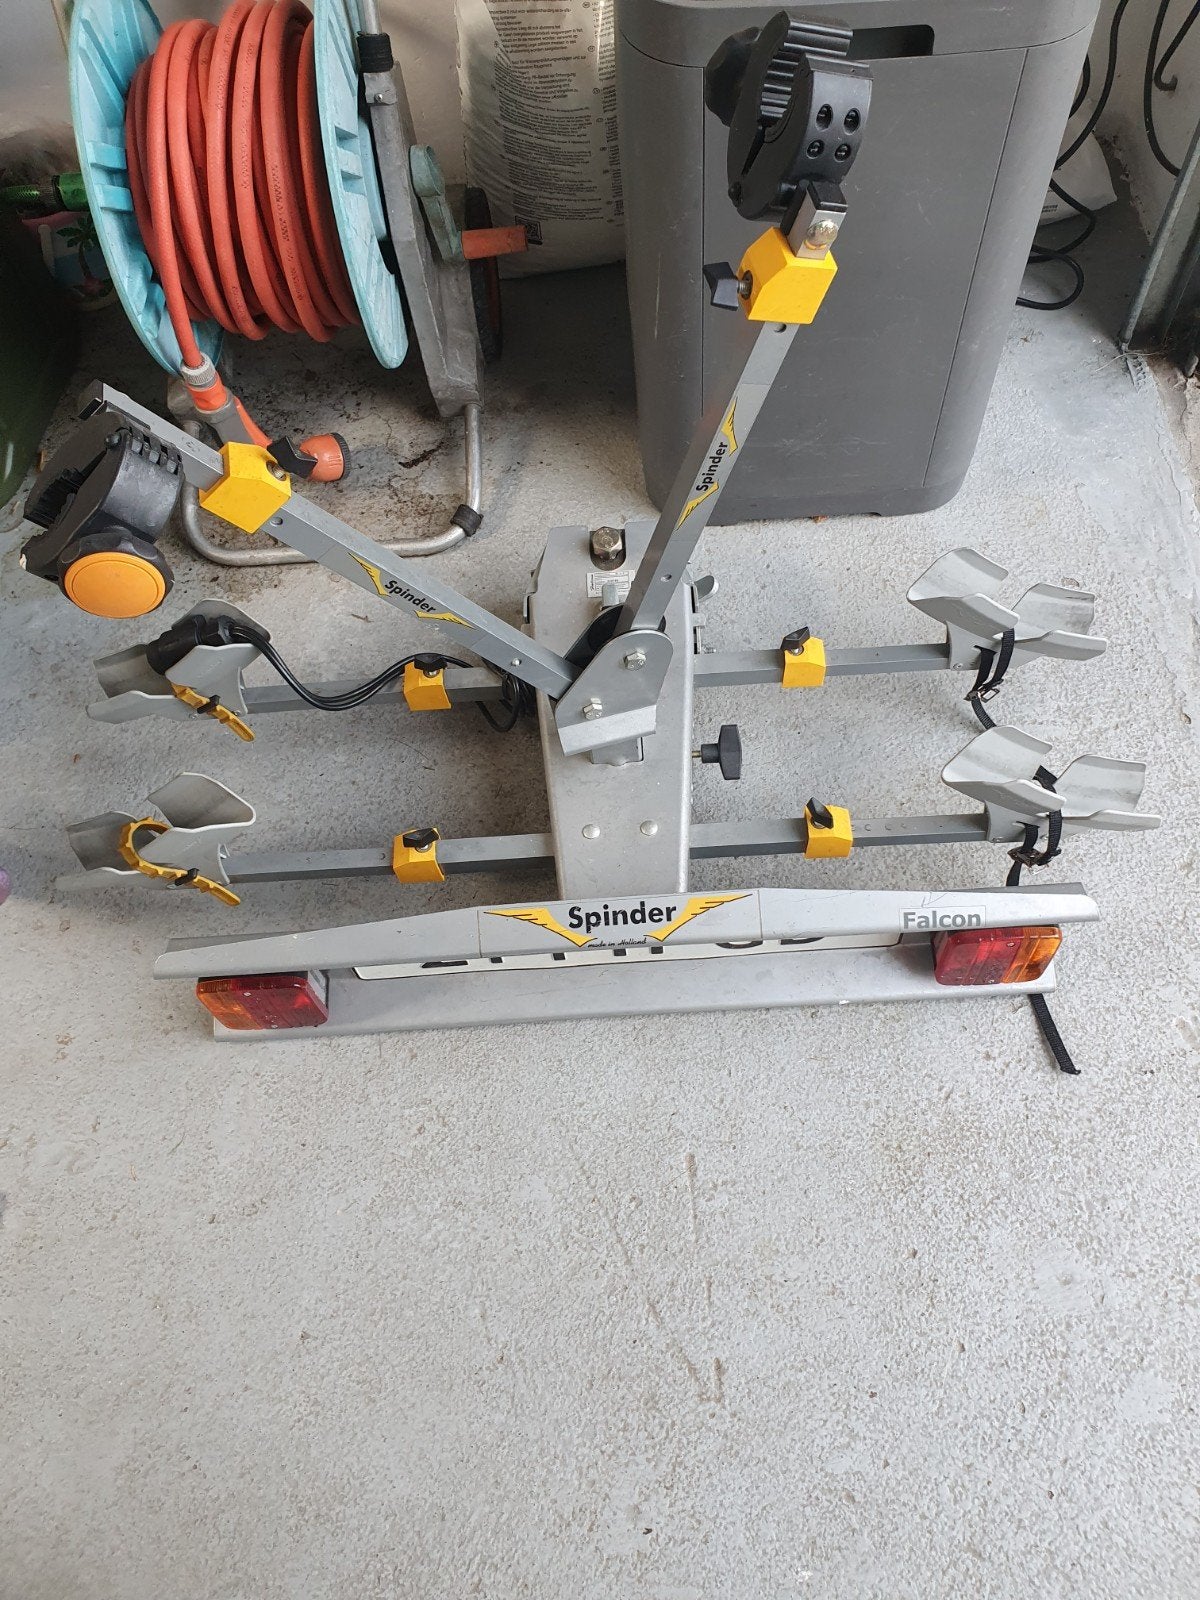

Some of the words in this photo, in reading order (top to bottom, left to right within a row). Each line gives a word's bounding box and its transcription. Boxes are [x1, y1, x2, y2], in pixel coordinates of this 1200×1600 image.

[696, 442, 728, 491] Spinder
[384, 580, 436, 612] Spinder
[568, 900, 677, 933] Spinder
[903, 910, 982, 929] Falcon
[587, 940, 606, 948] made
[617, 937, 647, 946] Holland
